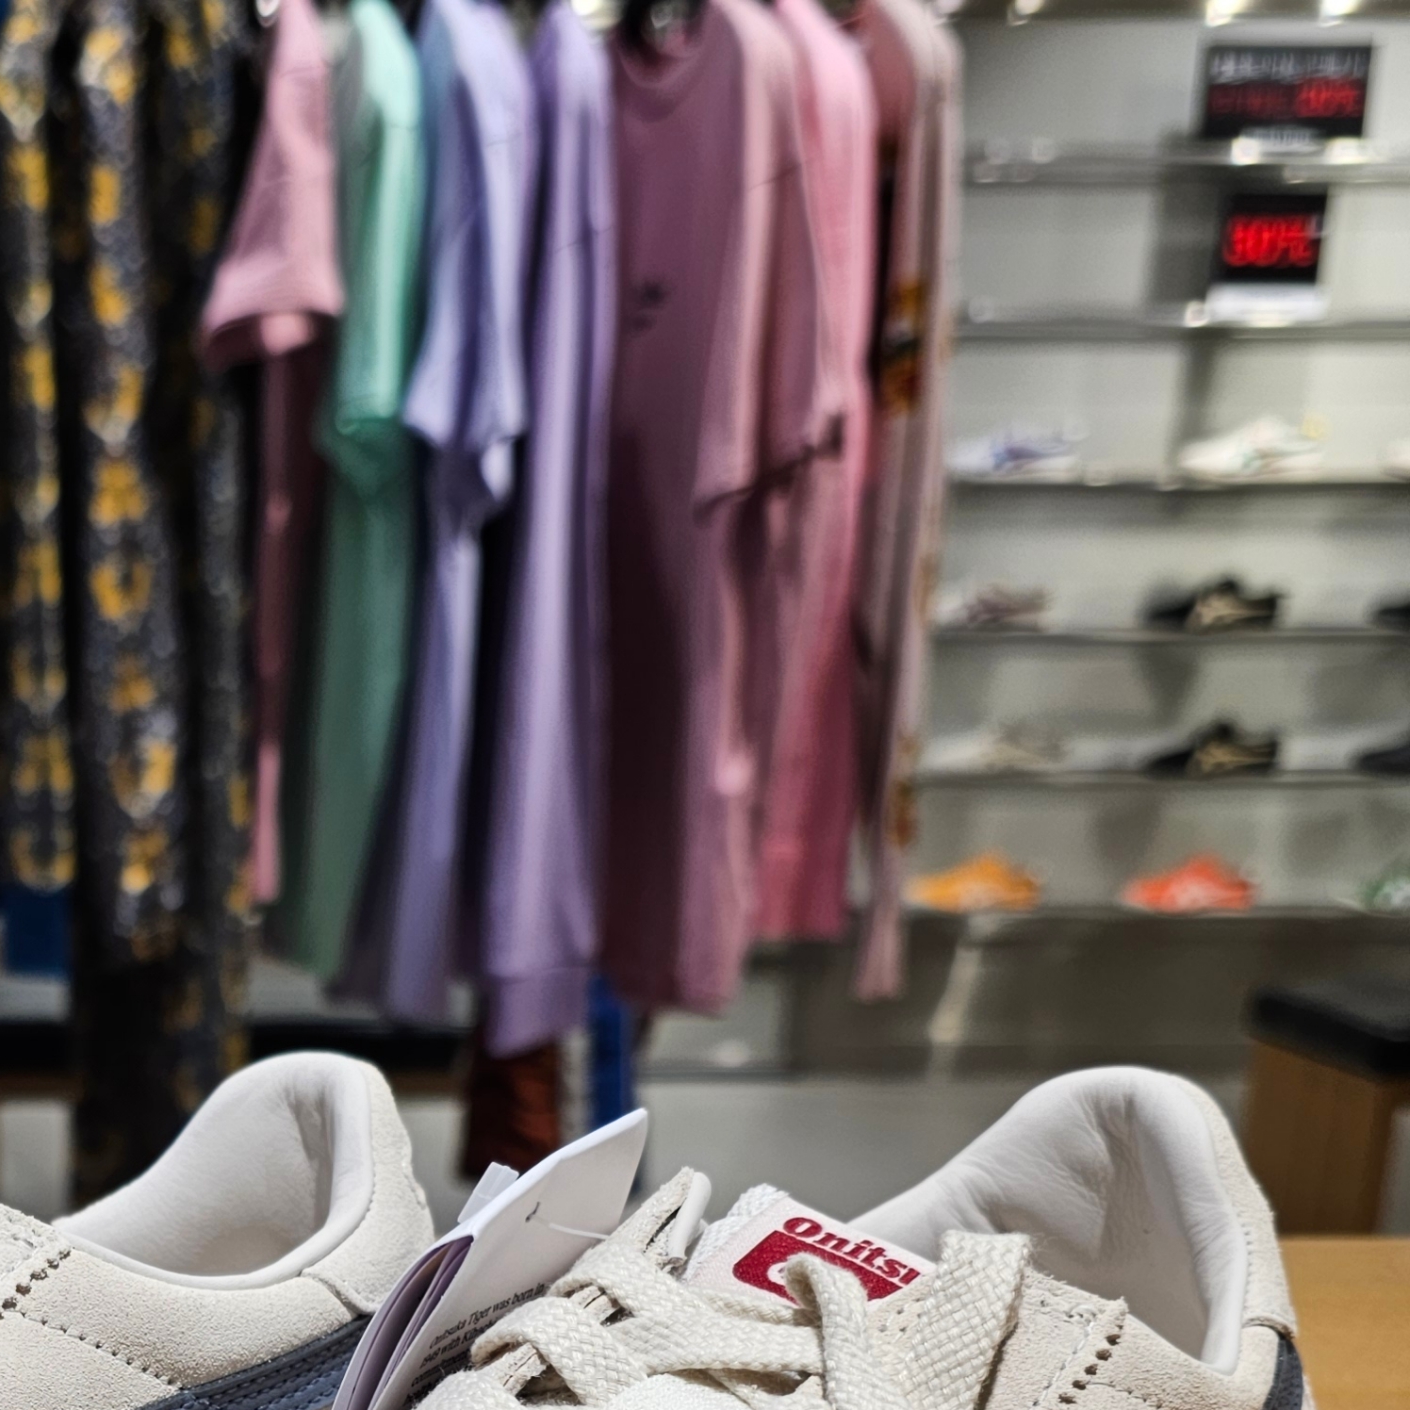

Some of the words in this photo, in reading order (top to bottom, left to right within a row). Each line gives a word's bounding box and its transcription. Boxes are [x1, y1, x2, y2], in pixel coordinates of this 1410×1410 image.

[467, 1305, 492, 1326] Tiger
[492, 1297, 511, 1313] was
[511, 1287, 534, 1305] born
